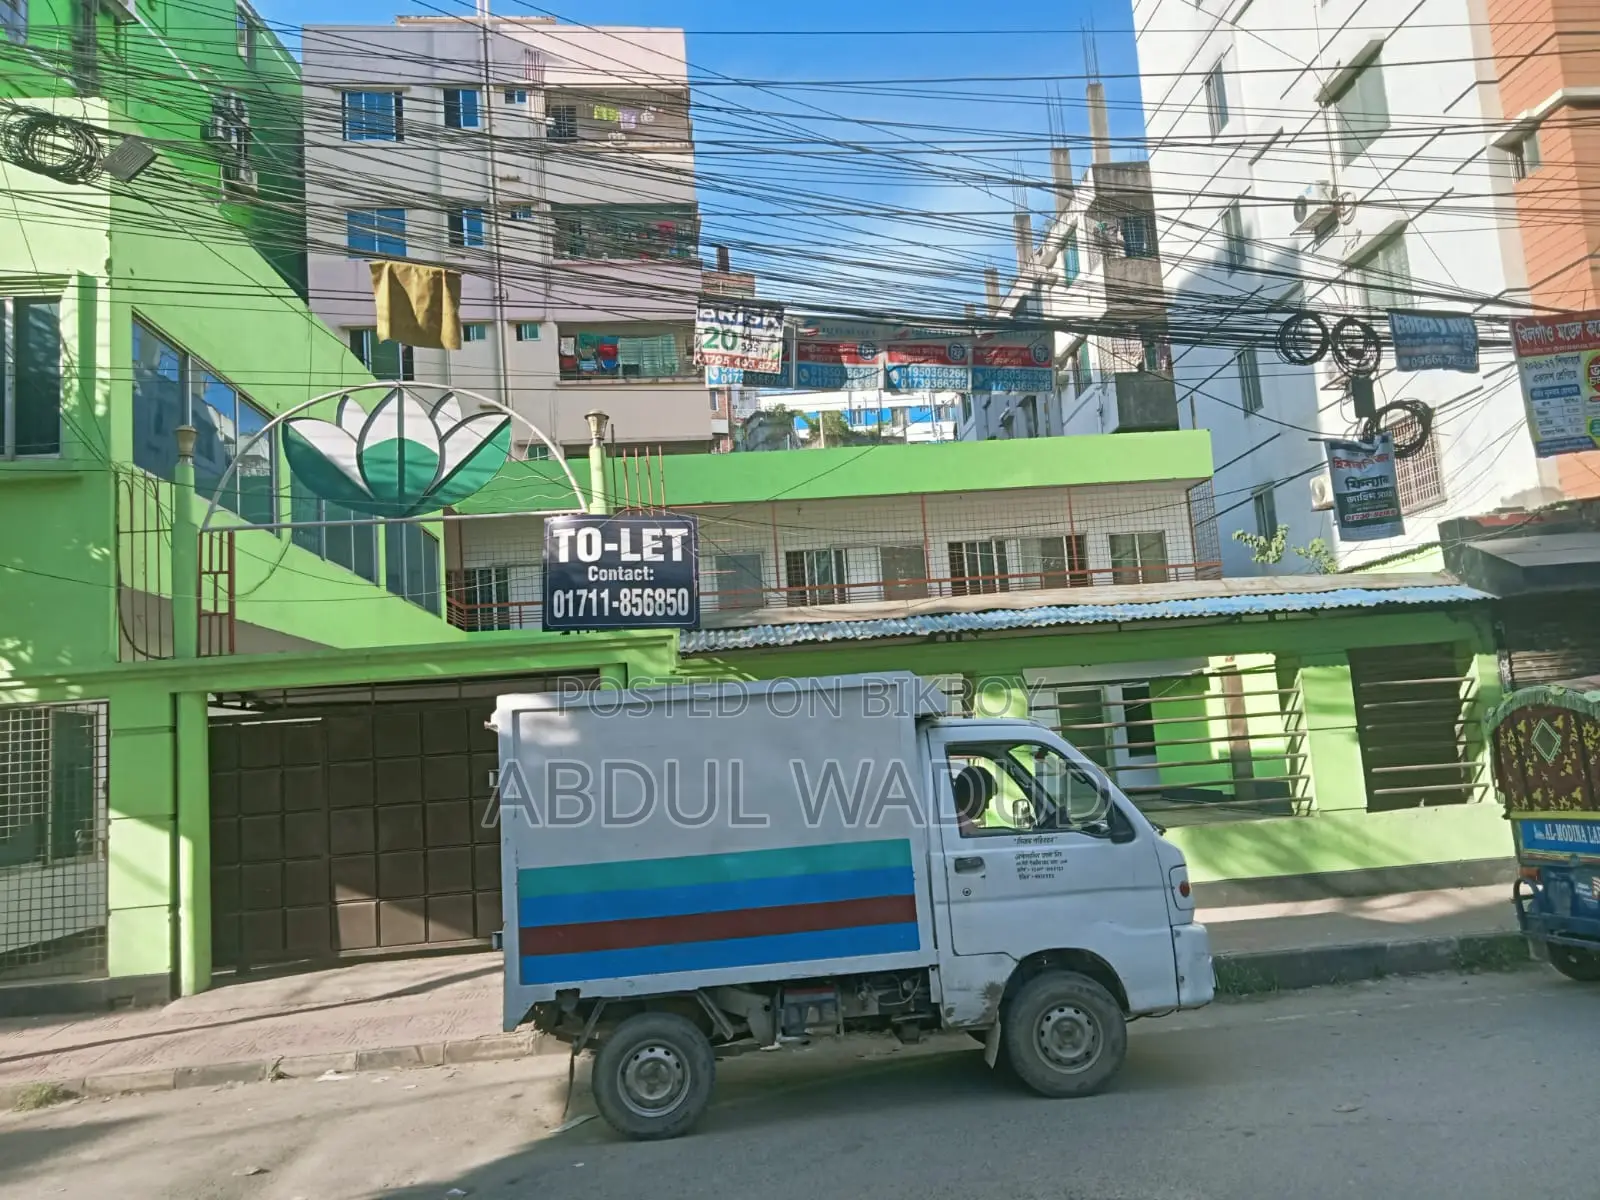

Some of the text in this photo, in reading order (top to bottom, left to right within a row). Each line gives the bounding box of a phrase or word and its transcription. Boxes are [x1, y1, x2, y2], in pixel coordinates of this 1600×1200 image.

[703, 326, 738, 351] 20
[901, 367, 967, 379] 01950366266
[901, 378, 967, 389] 01739366266
[552, 526, 689, 563] TO-LET
[588, 565, 655, 582] Contact:
[553, 587, 689, 618] 01711-856850
